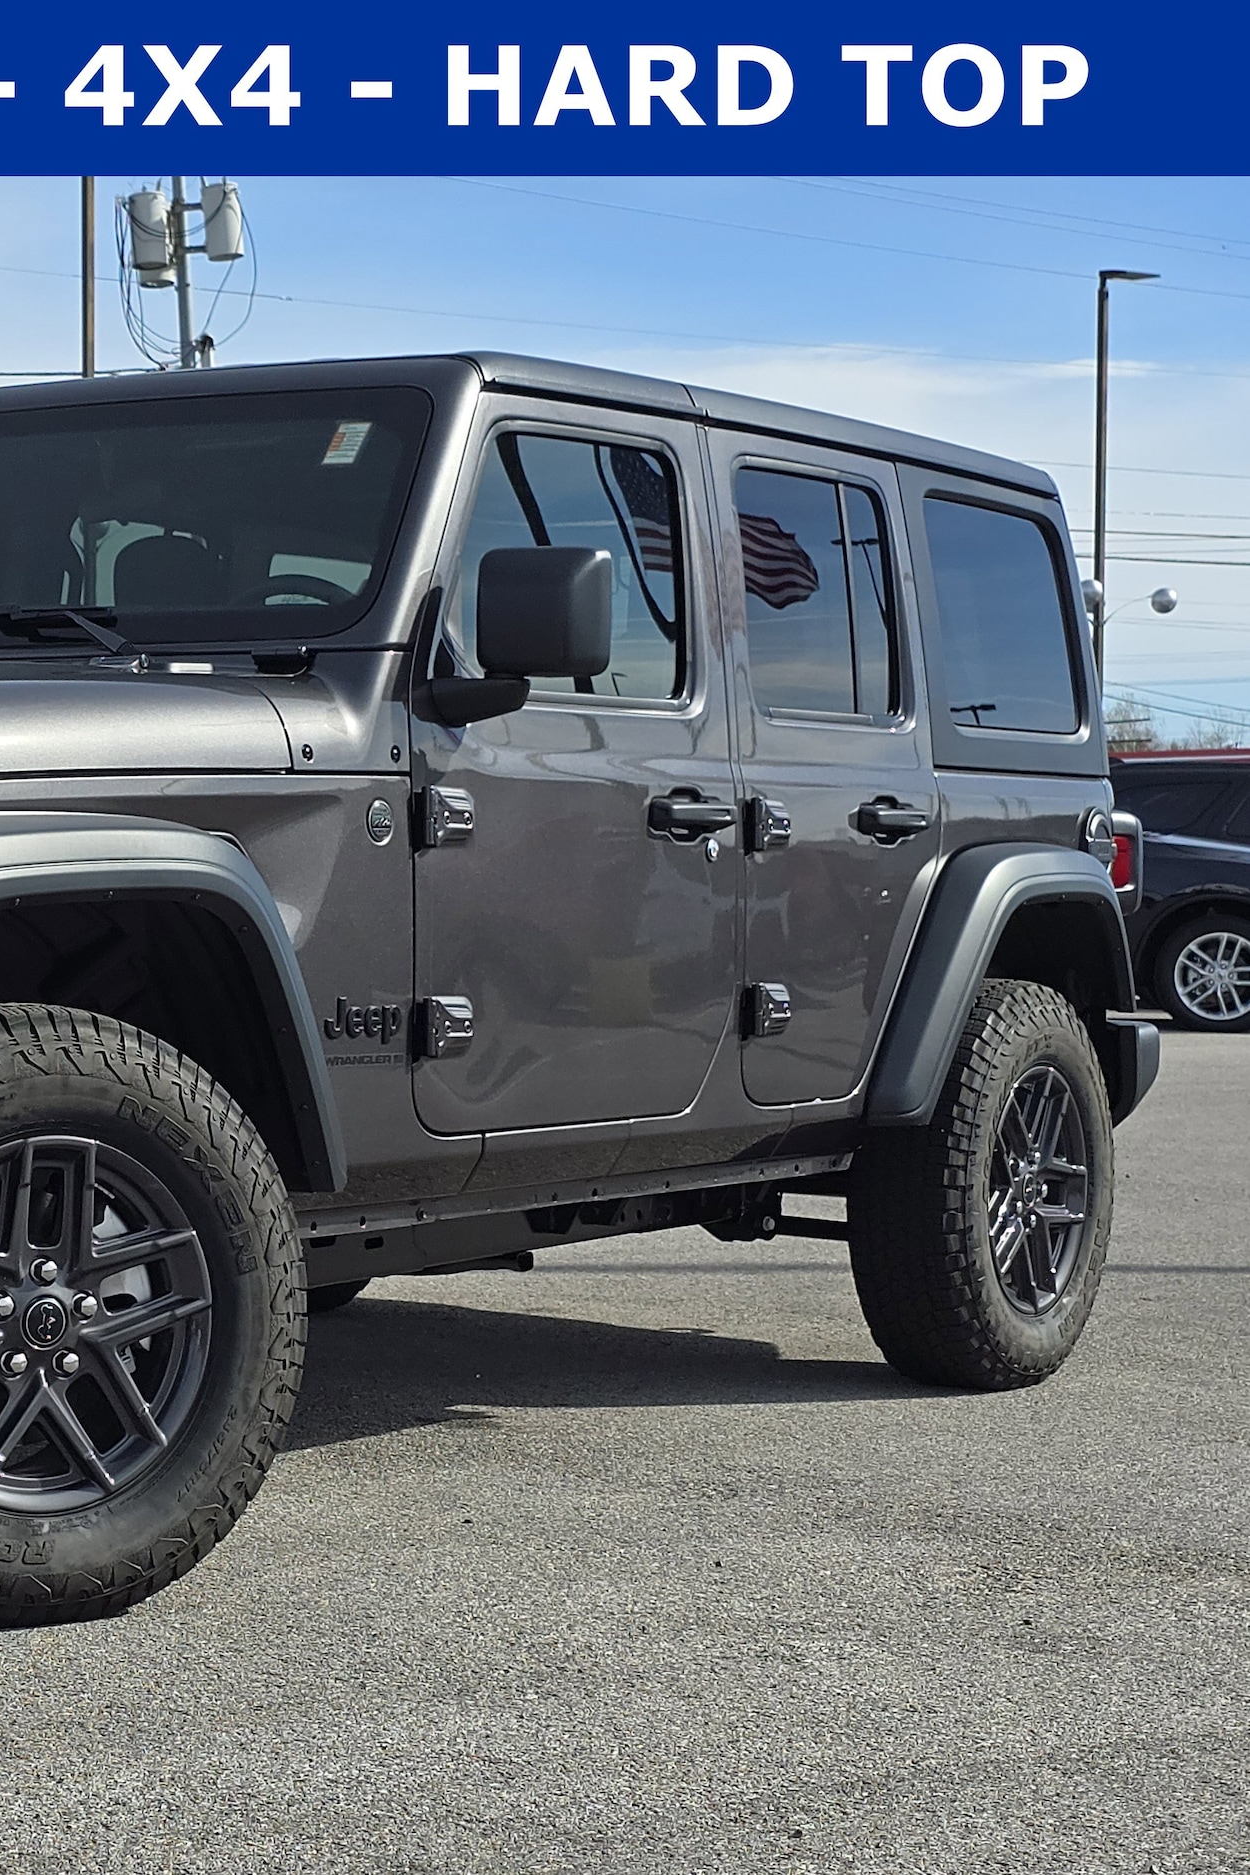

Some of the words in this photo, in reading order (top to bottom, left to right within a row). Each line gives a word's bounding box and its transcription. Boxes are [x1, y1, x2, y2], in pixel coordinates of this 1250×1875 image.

[323, 996, 401, 1045] Jeep
[325, 1054, 392, 1067] WRANGLER
[117, 1094, 259, 1276] NEXEN
